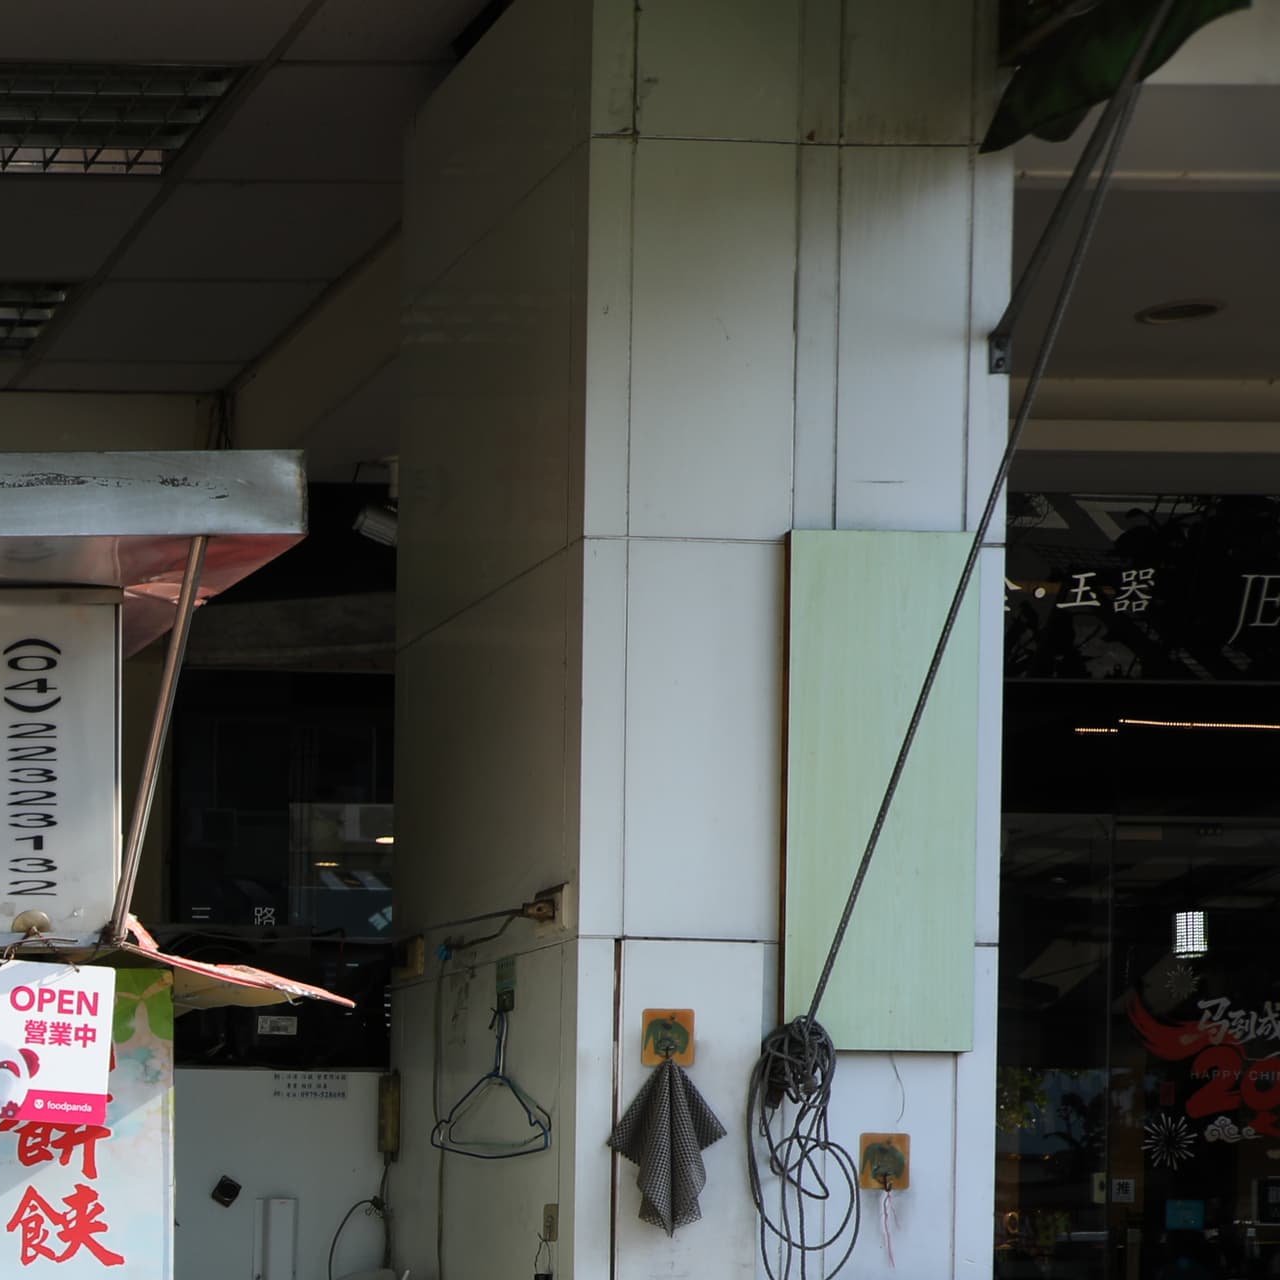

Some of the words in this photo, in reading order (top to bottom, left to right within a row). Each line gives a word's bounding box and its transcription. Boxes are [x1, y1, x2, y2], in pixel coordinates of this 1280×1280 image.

[4, 638, 61, 898] (04)22323132
[10, 985, 99, 1016] OPEN
[24, 1020, 97, 1048] 營業中
[47, 1101, 92, 1113] foodpanda
